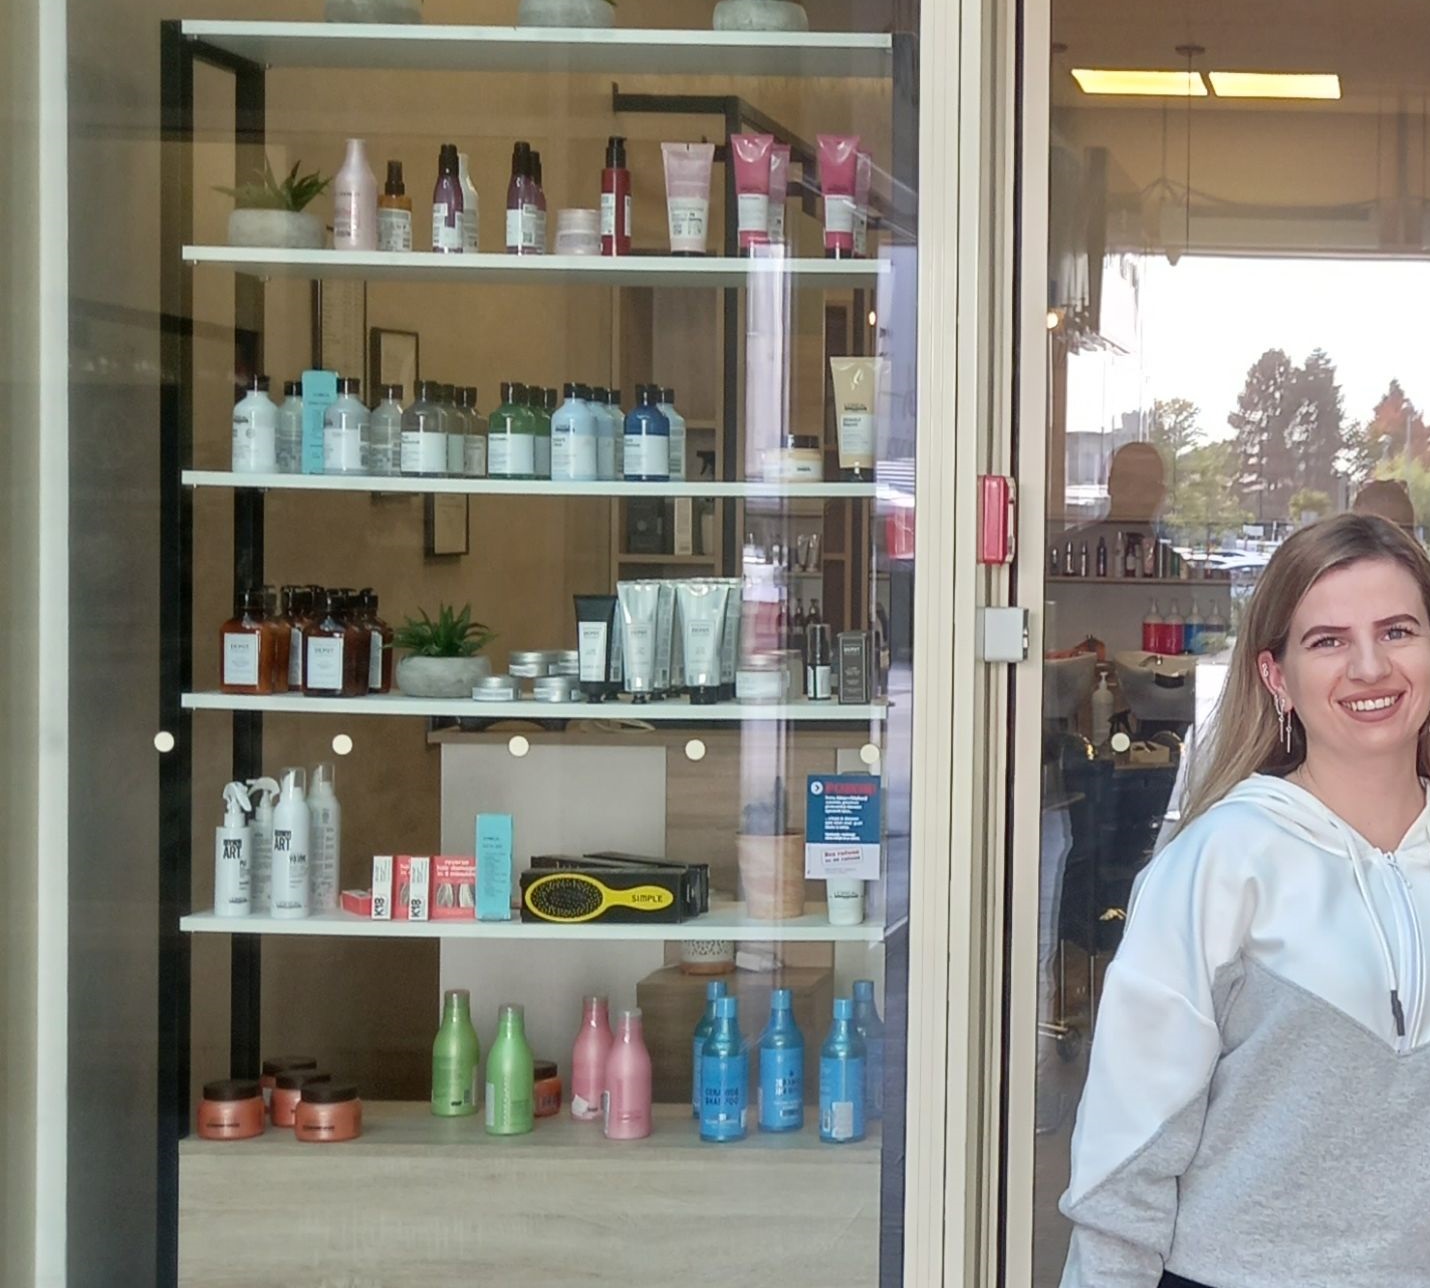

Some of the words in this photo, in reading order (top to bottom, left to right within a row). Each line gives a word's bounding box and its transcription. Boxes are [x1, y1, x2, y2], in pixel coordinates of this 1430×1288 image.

[374, 897, 385, 917] K18
[410, 898, 422, 918] K18
[631, 894, 663, 903] SIMPLE
